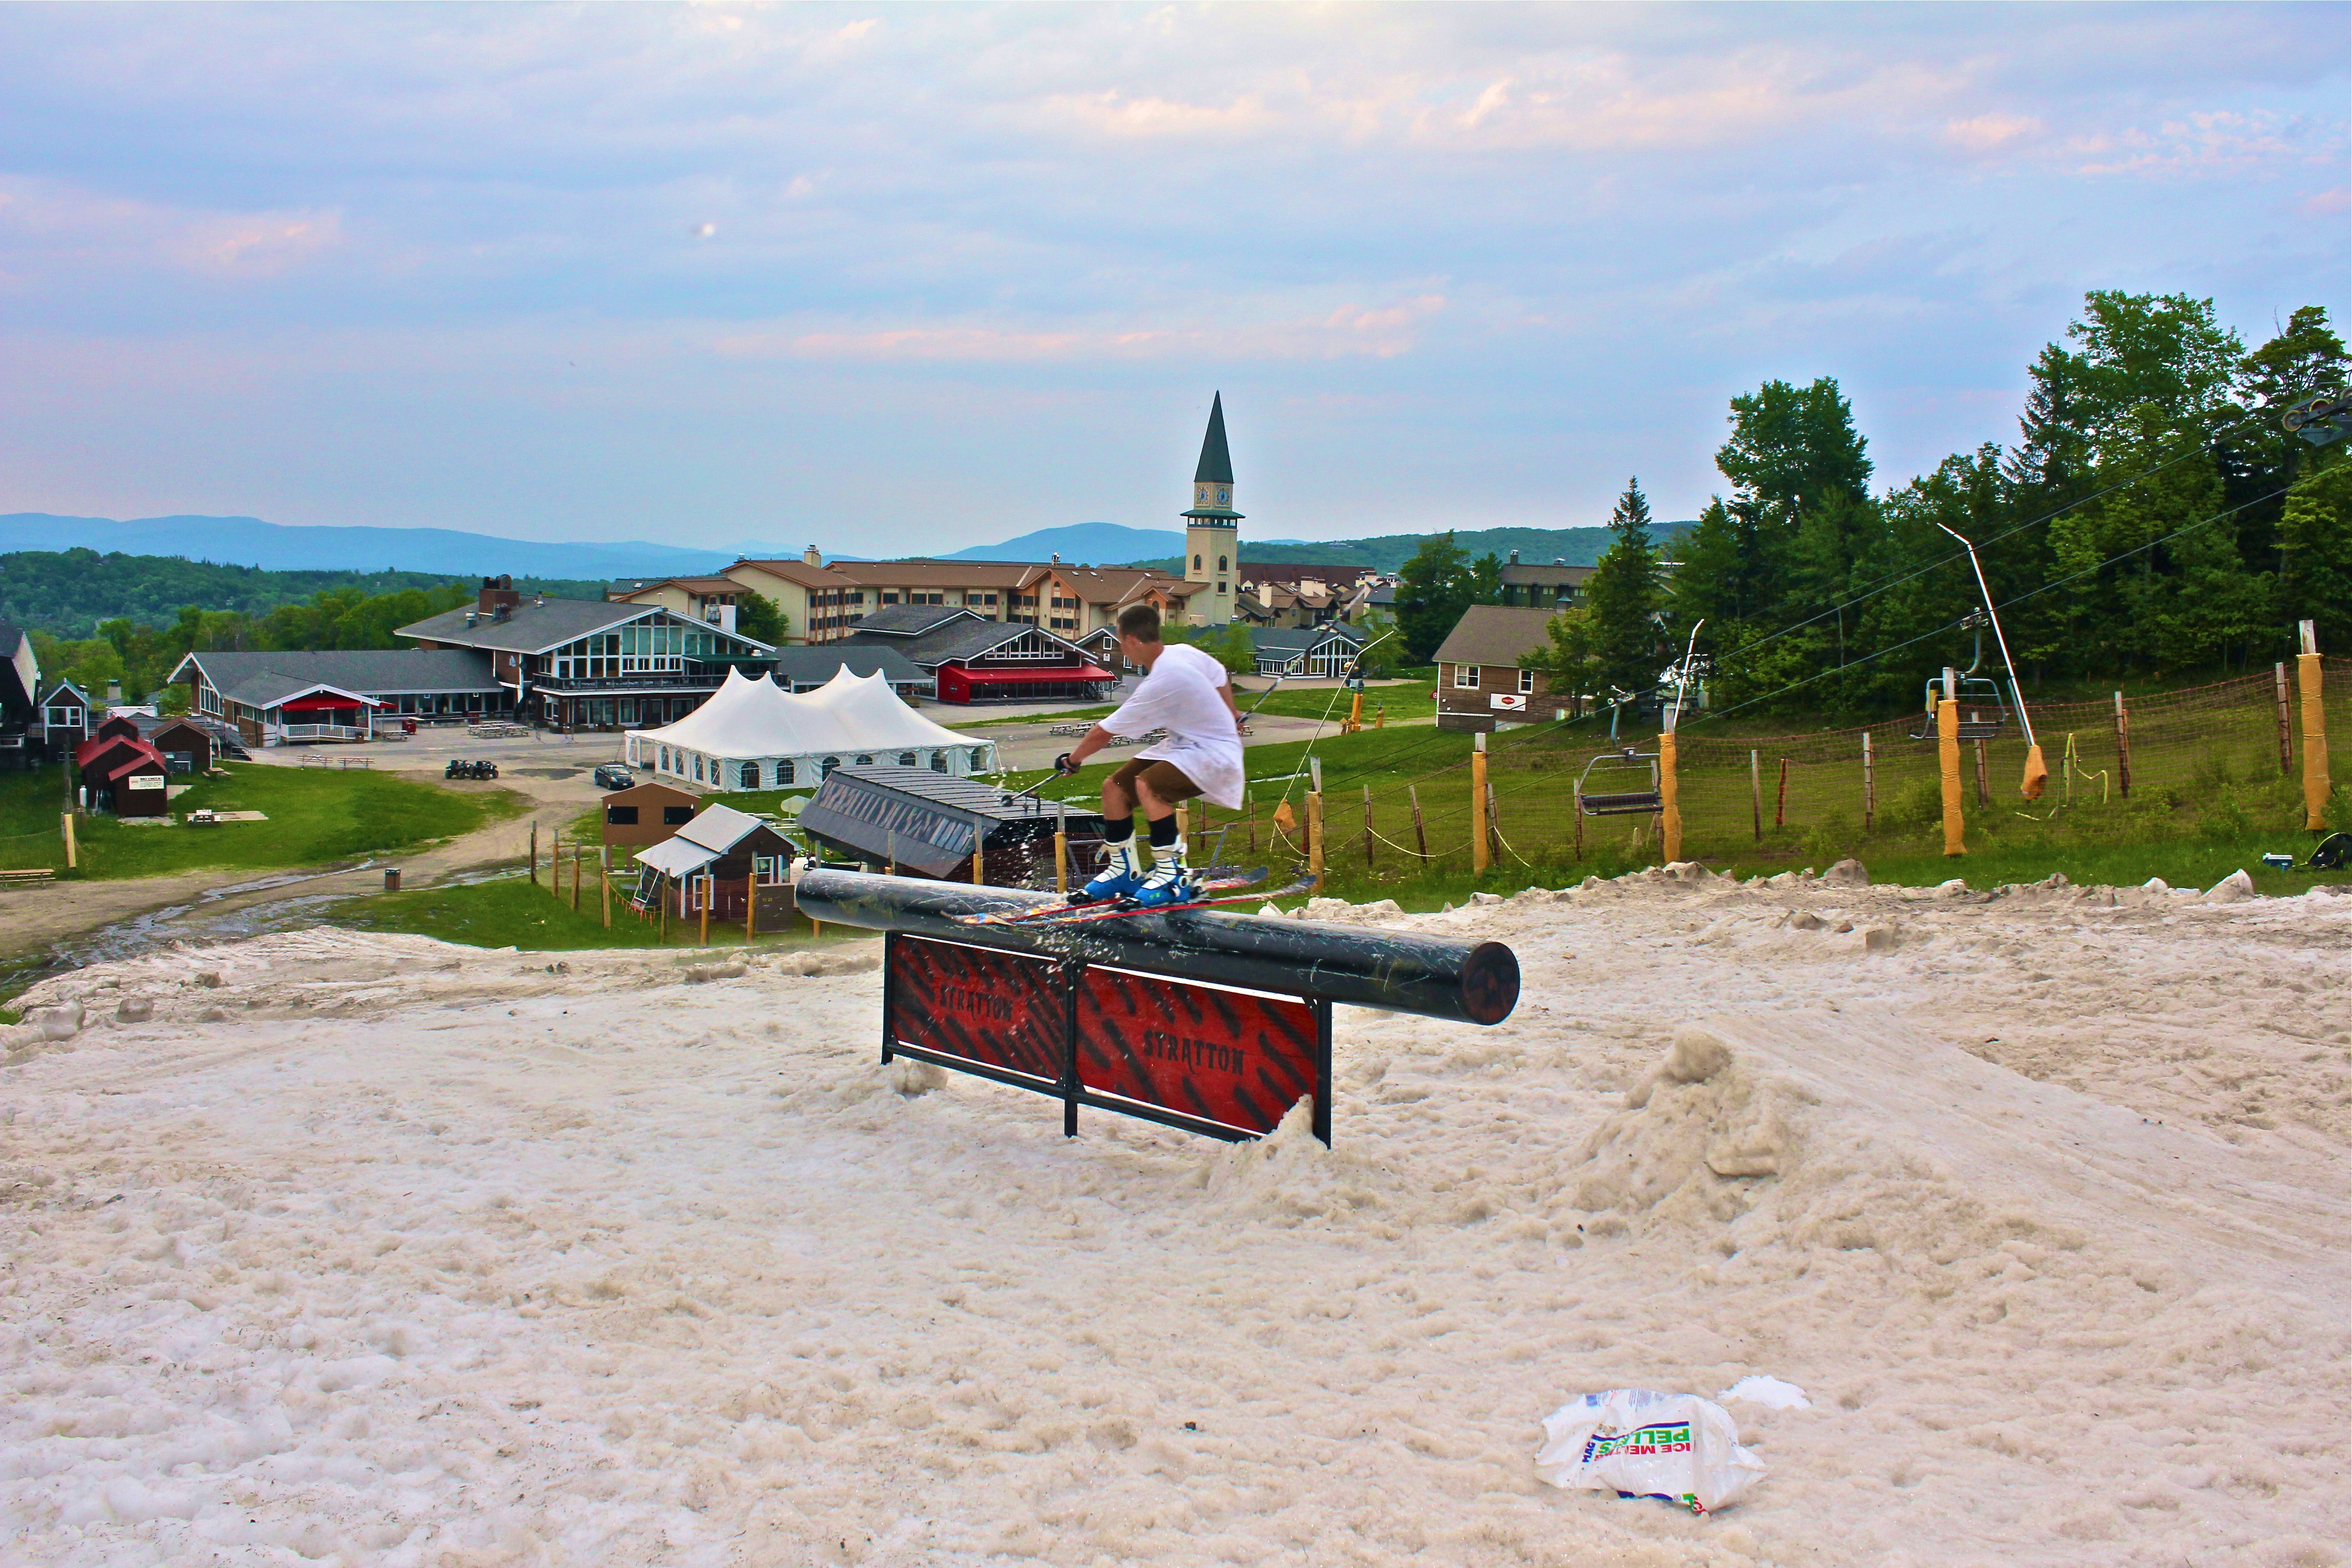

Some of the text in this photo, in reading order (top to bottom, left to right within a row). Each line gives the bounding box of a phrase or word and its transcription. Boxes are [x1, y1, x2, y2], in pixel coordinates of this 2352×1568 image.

[940, 984, 1013, 1021] STRATTON
[1144, 1029, 1244, 1076] STRATTON
[1581, 1441, 1596, 1463] MAG
[1661, 1442, 1690, 1453] ICE
